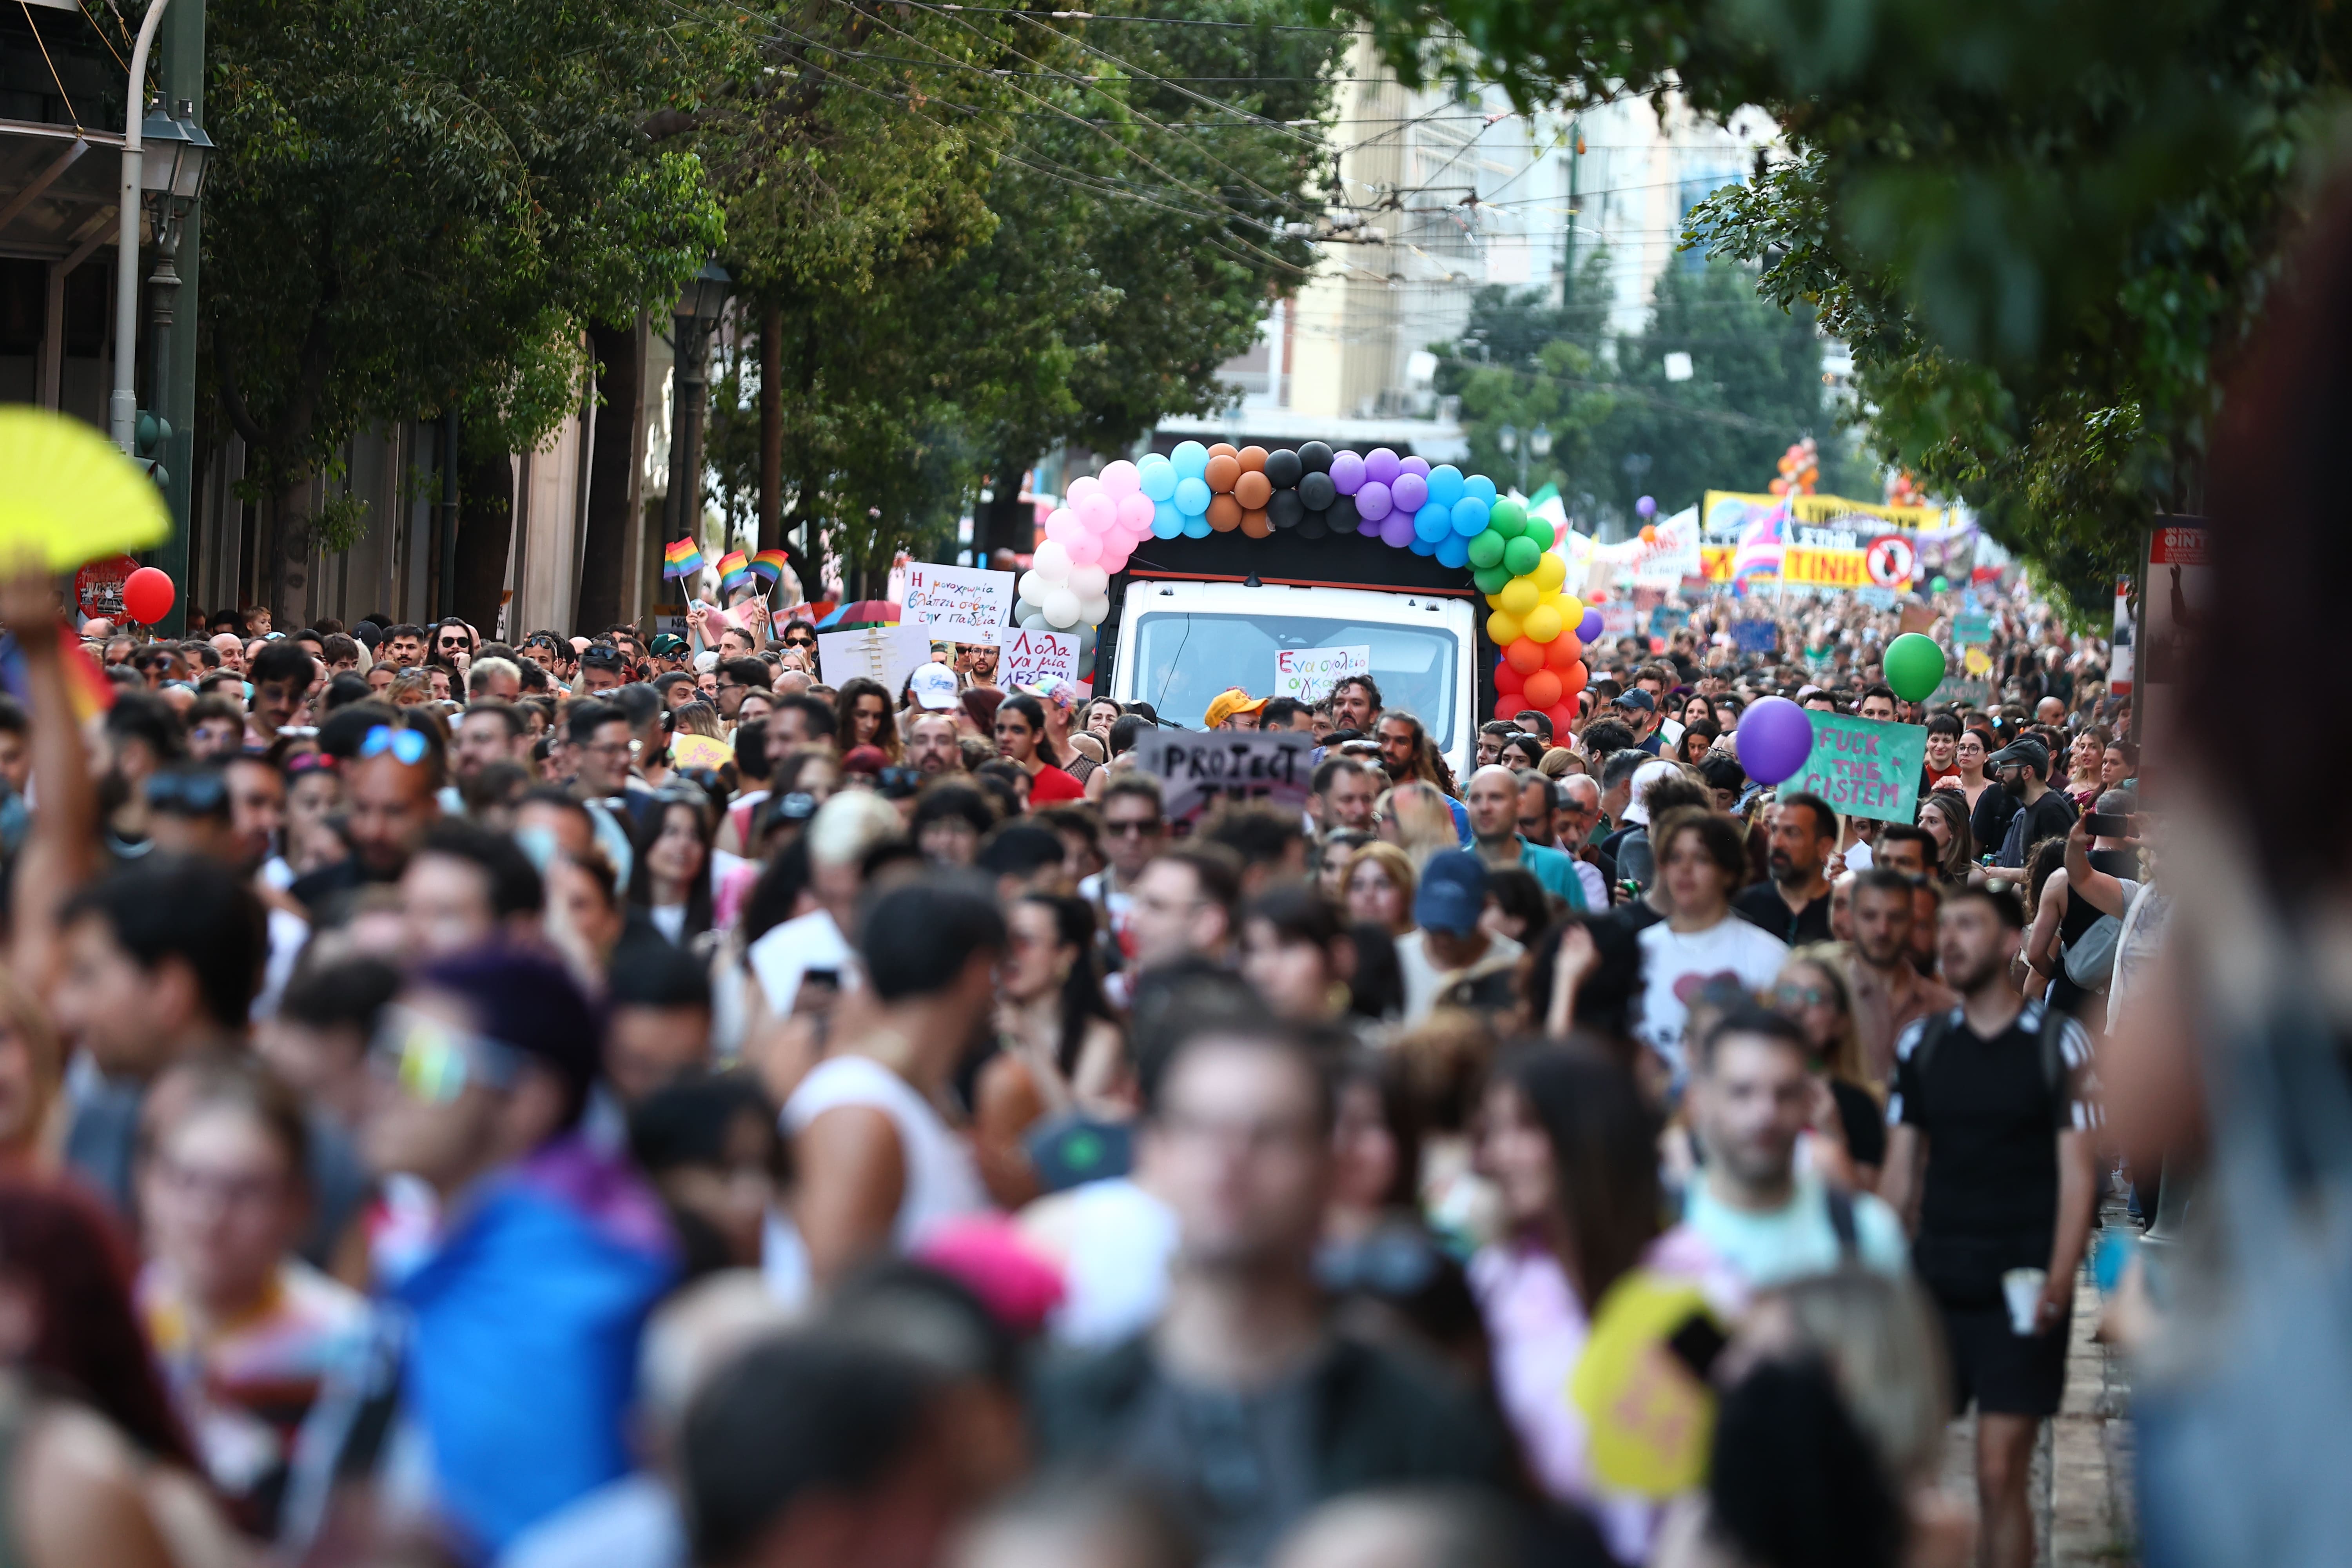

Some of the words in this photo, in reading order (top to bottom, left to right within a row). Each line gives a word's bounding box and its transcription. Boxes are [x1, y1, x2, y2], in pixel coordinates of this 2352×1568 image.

[912, 572, 922, 587] Η
[931, 580, 994, 598] μονοχρωμία
[908, 591, 955, 609] βλάπτει
[959, 596, 997, 617] σοβαρά
[1008, 656, 1031, 669] να
[1320, 651, 1366, 677] σχολείο
[1819, 727, 1880, 757] FUCK
[1831, 758, 1882, 780] THE
